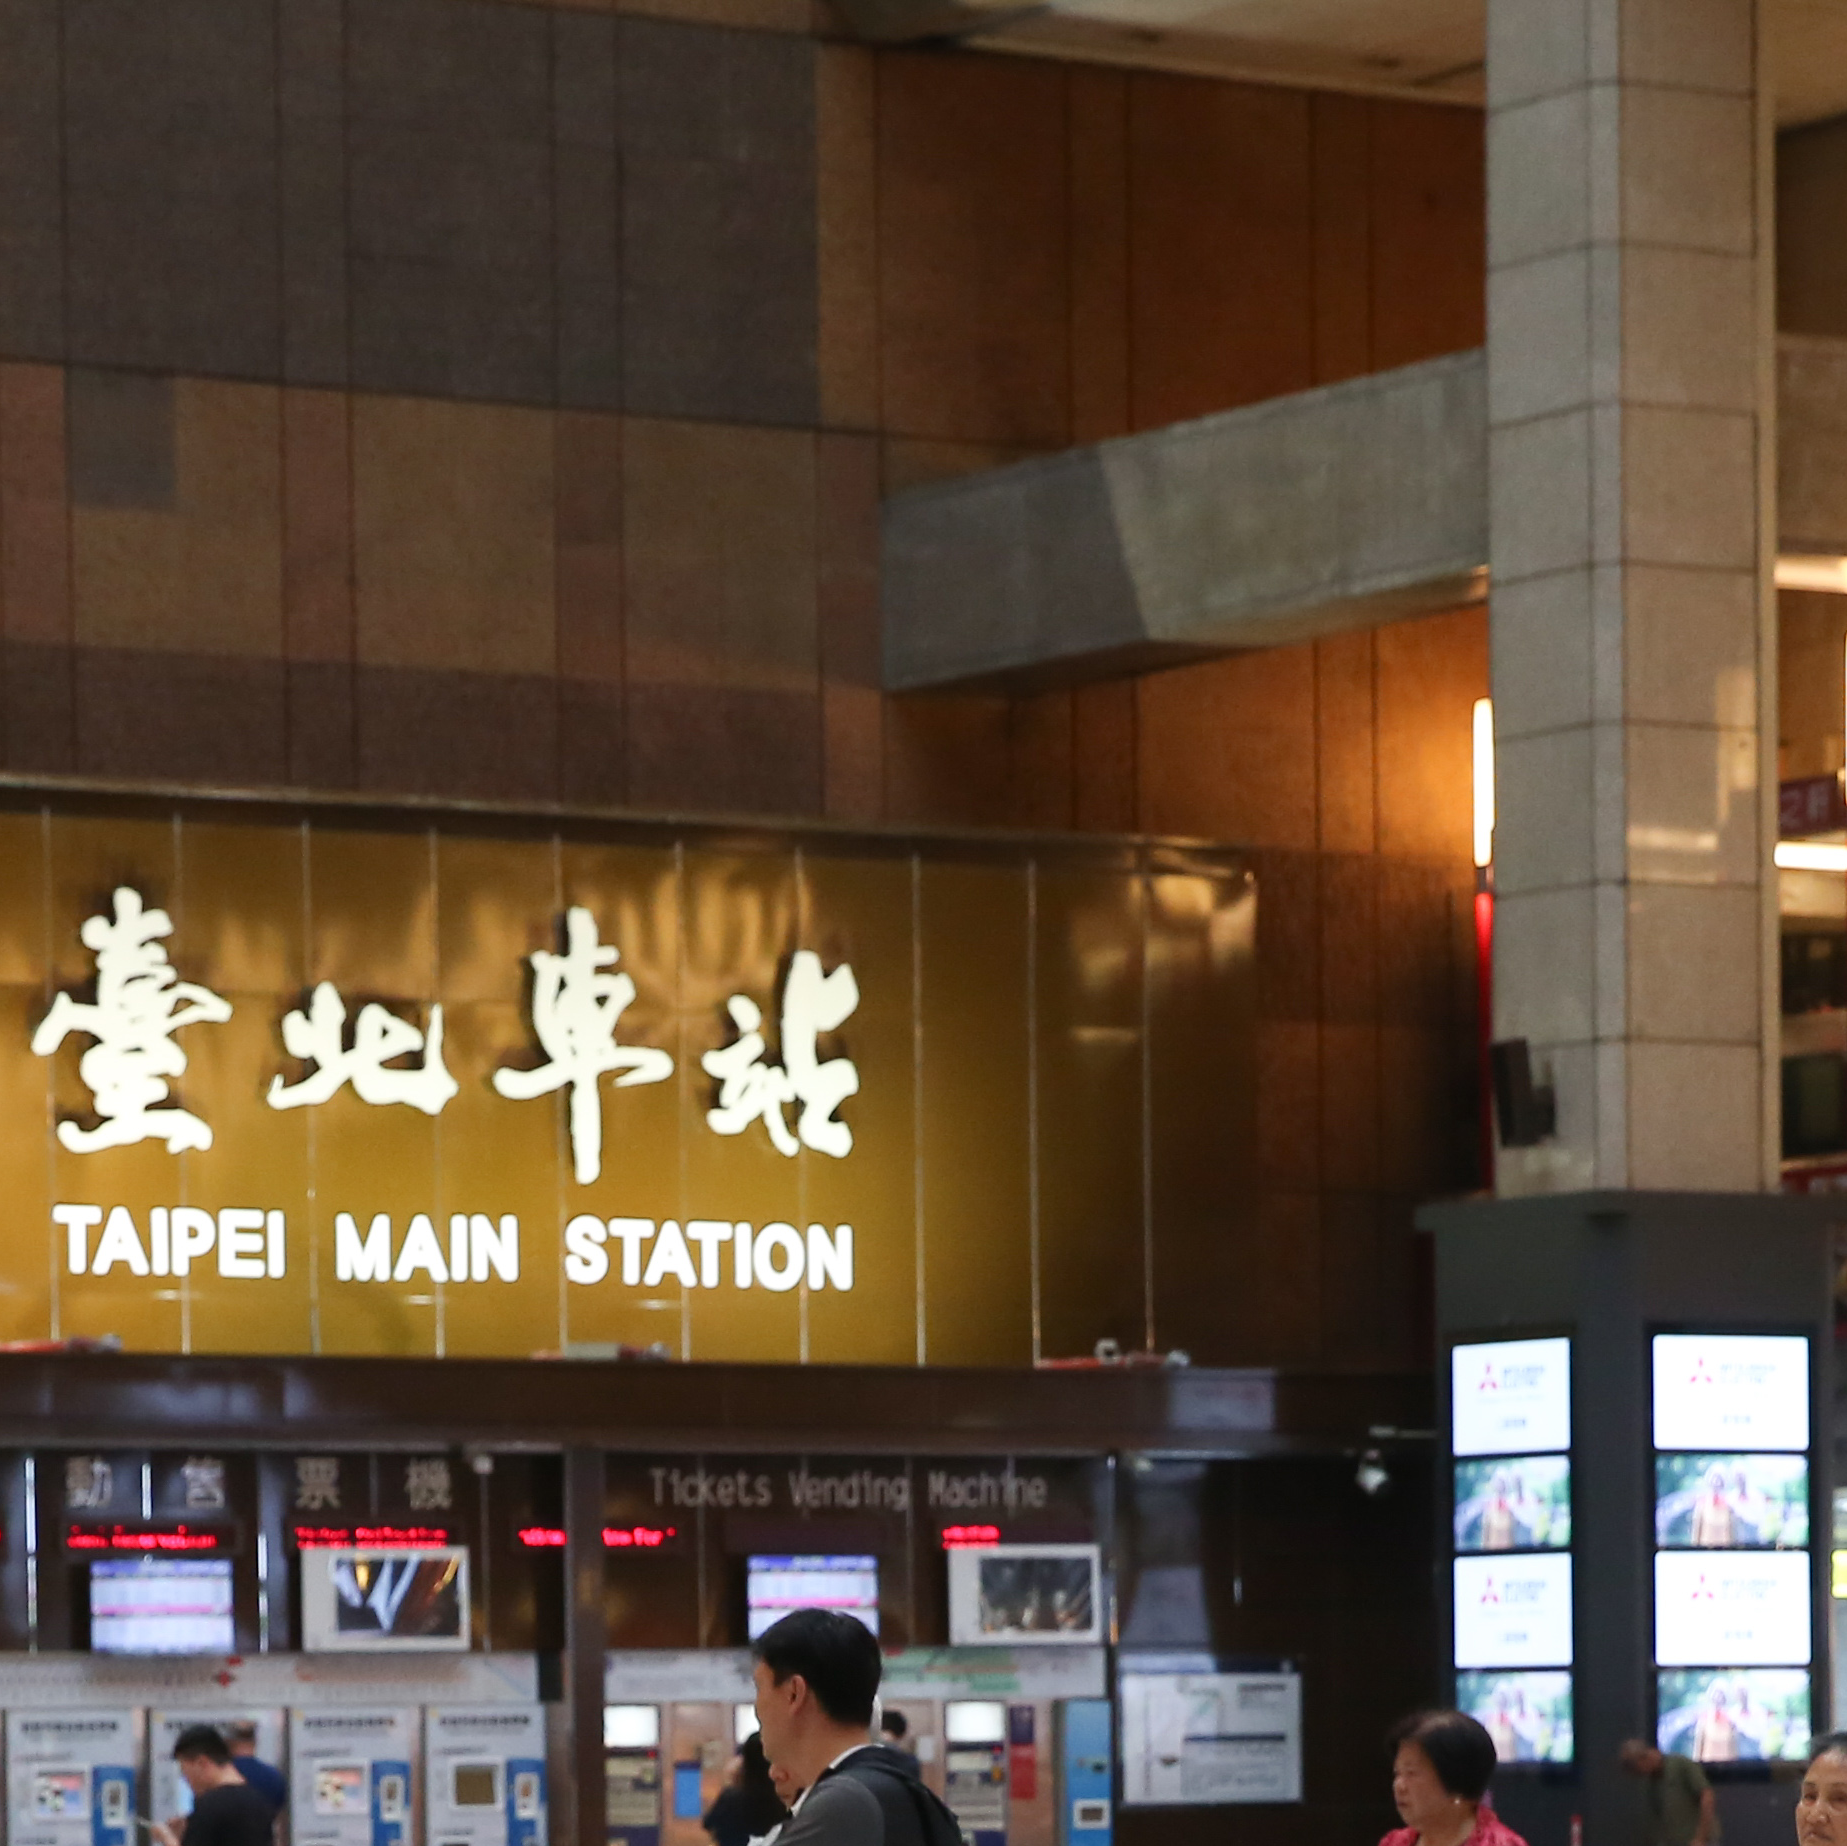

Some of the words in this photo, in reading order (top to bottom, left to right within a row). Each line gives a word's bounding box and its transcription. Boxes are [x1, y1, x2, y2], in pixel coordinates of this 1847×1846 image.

[32, 886, 860, 1184] 臺北車站
[53, 1204, 286, 1280] TAIPEI
[335, 1210, 520, 1285] MAIN
[564, 1215, 855, 1293] STATION
[650, 1466, 772, 1507] Tickets
[788, 1469, 911, 1512] Vending
[927, 1470, 1048, 1508] Machine
